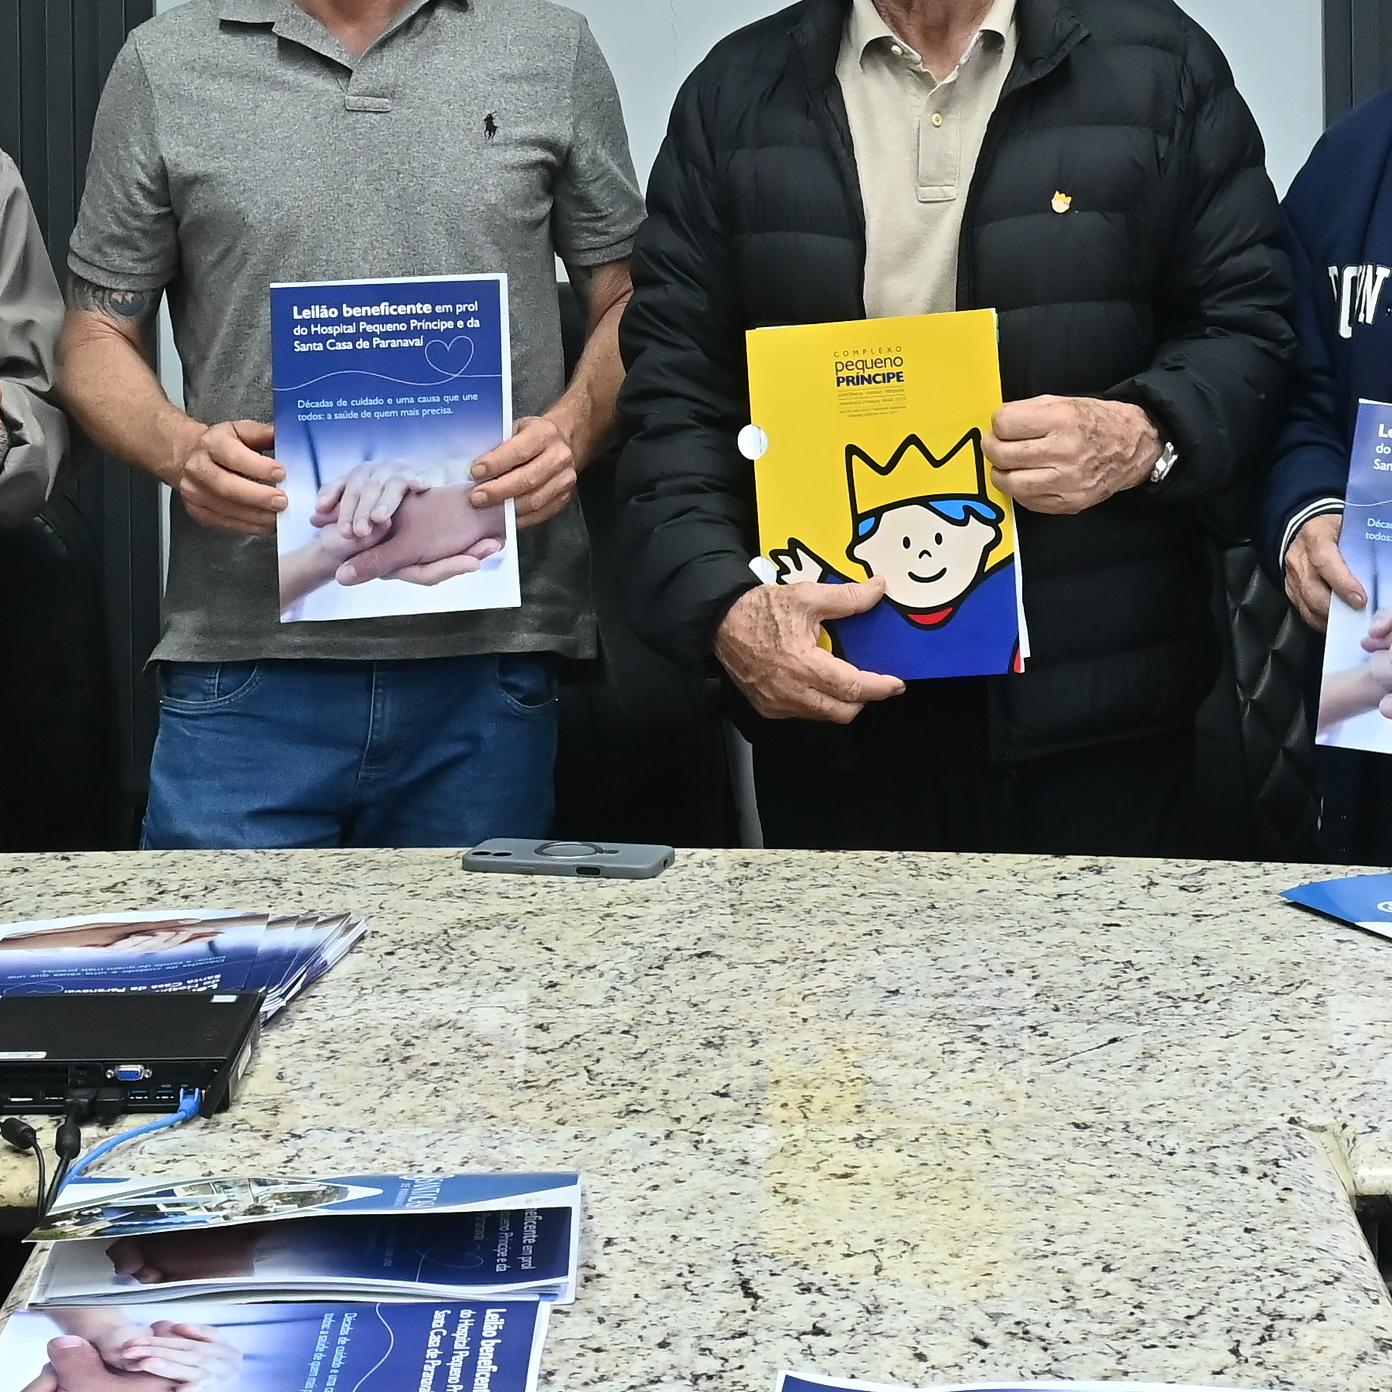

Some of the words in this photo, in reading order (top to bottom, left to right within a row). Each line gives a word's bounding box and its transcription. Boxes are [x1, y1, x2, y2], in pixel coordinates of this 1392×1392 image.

[293, 305, 338, 319] Leilão
[343, 302, 432, 317] beneficente
[435, 305, 453, 313] em
[456, 301, 478, 315] prol
[293, 325, 308, 335] do
[311, 322, 356, 336] Hospital
[360, 322, 407, 334] Pequeno
[410, 319, 454, 332] Príncipe
[457, 320, 464, 328] e
[467, 317, 480, 328] da
[294, 341, 323, 352] Santa
[326, 339, 353, 350] Casa
[355, 338, 370, 349] de
[373, 335, 423, 348] Paranavaí
[833, 346, 902, 358] COMPLEXO
[835, 356, 904, 376] pequeno
[836, 371, 905, 387] PRÍNCIPE
[298, 399, 333, 408] Décadas
[336, 398, 348, 407] de
[351, 397, 384, 406] cuidado
[443, 395, 459, 404] que
[298, 412, 324, 421] todos:
[334, 410, 359, 419] saúde
[360, 410, 372, 418] de
[374, 410, 398, 420] quem
[401, 408, 419, 416] mais
[422, 407, 453, 418] precisa.
[1376, 443, 1391, 454] do
[432, 1309, 451, 1328] Santa
[460, 1309, 477, 1318] do
[482, 1308, 507, 1337] Leilão
[428, 1329, 447, 1348] Casa
[451, 1319, 475, 1349] Hospital
[425, 1348, 443, 1359] de
[446, 1350, 470, 1384] Pequeno
